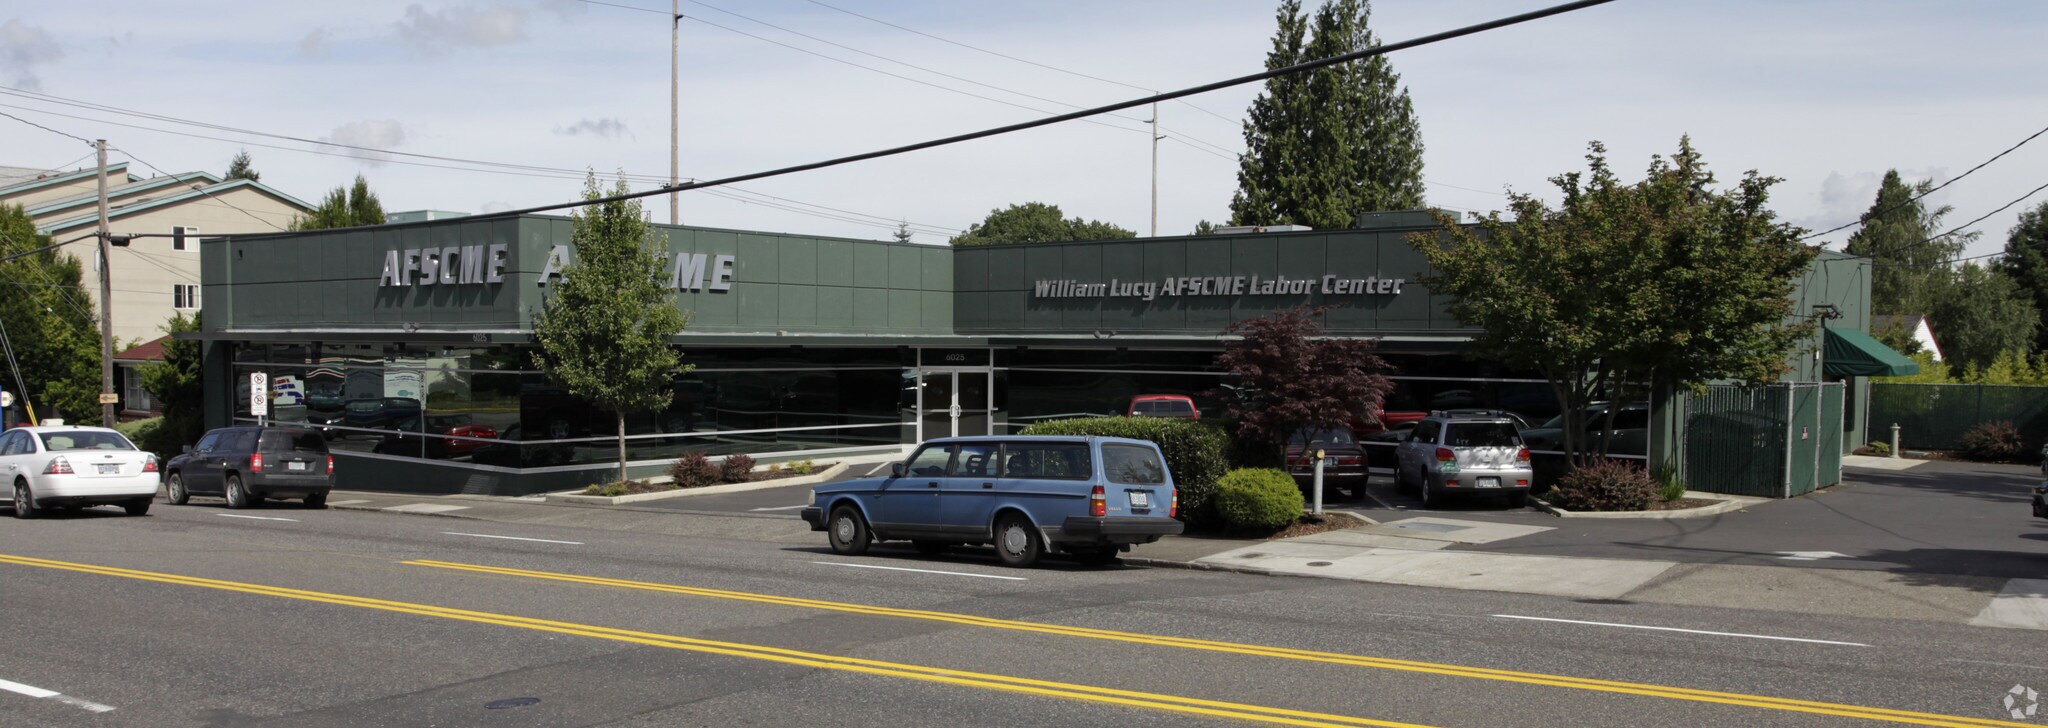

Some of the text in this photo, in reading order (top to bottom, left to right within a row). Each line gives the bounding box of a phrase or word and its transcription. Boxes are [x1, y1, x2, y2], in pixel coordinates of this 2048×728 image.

[380, 243, 508, 287] AFSCME
[537, 244, 735, 291] AME
[1035, 274, 1405, 301] William Lucy AFSCME Labor Center
[945, 353, 965, 361] 6025
